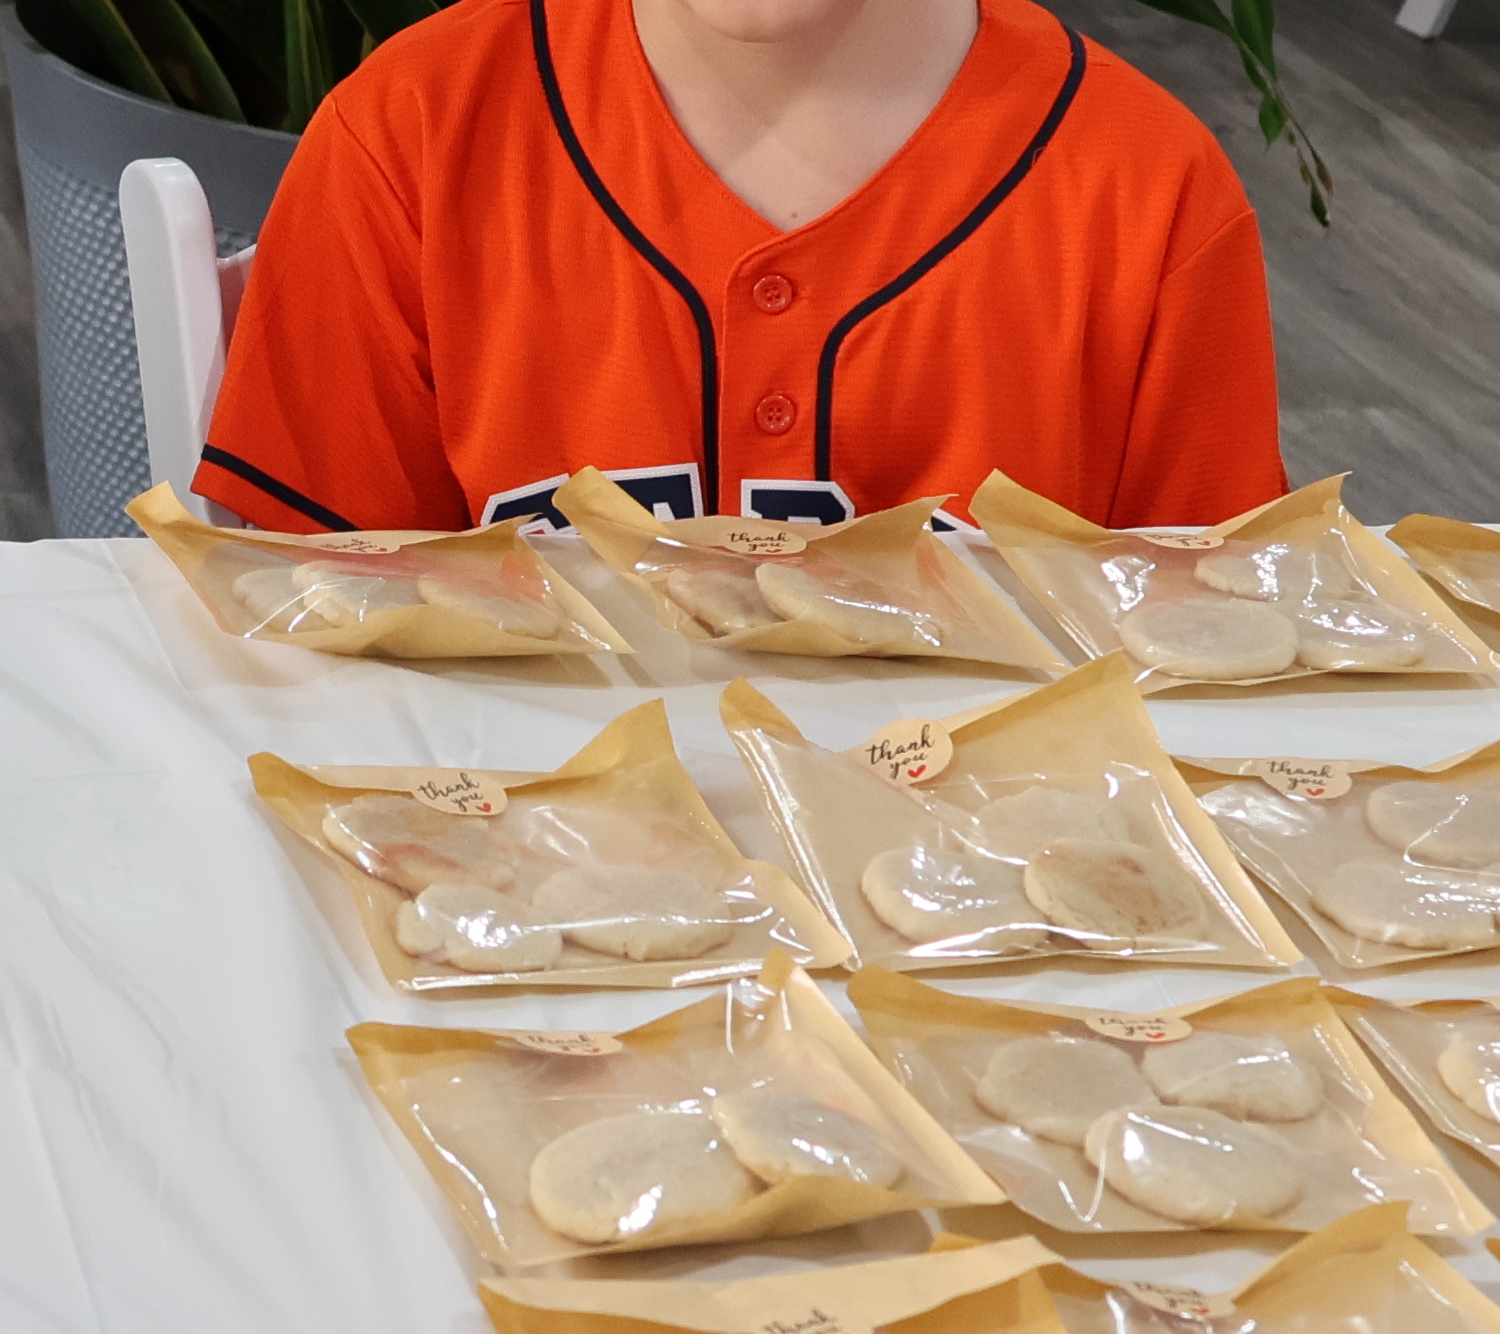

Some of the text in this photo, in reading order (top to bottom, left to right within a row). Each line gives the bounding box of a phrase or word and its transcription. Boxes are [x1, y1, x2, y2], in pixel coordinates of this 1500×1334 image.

[728, 531, 790, 543] thank
[747, 542, 786, 552] you
[866, 724, 935, 765] thank
[890, 753, 928, 780] you
[1266, 760, 1335, 779] thank
[416, 771, 481, 801] thank
[1286, 777, 1327, 791] you
[450, 792, 485, 813] you
